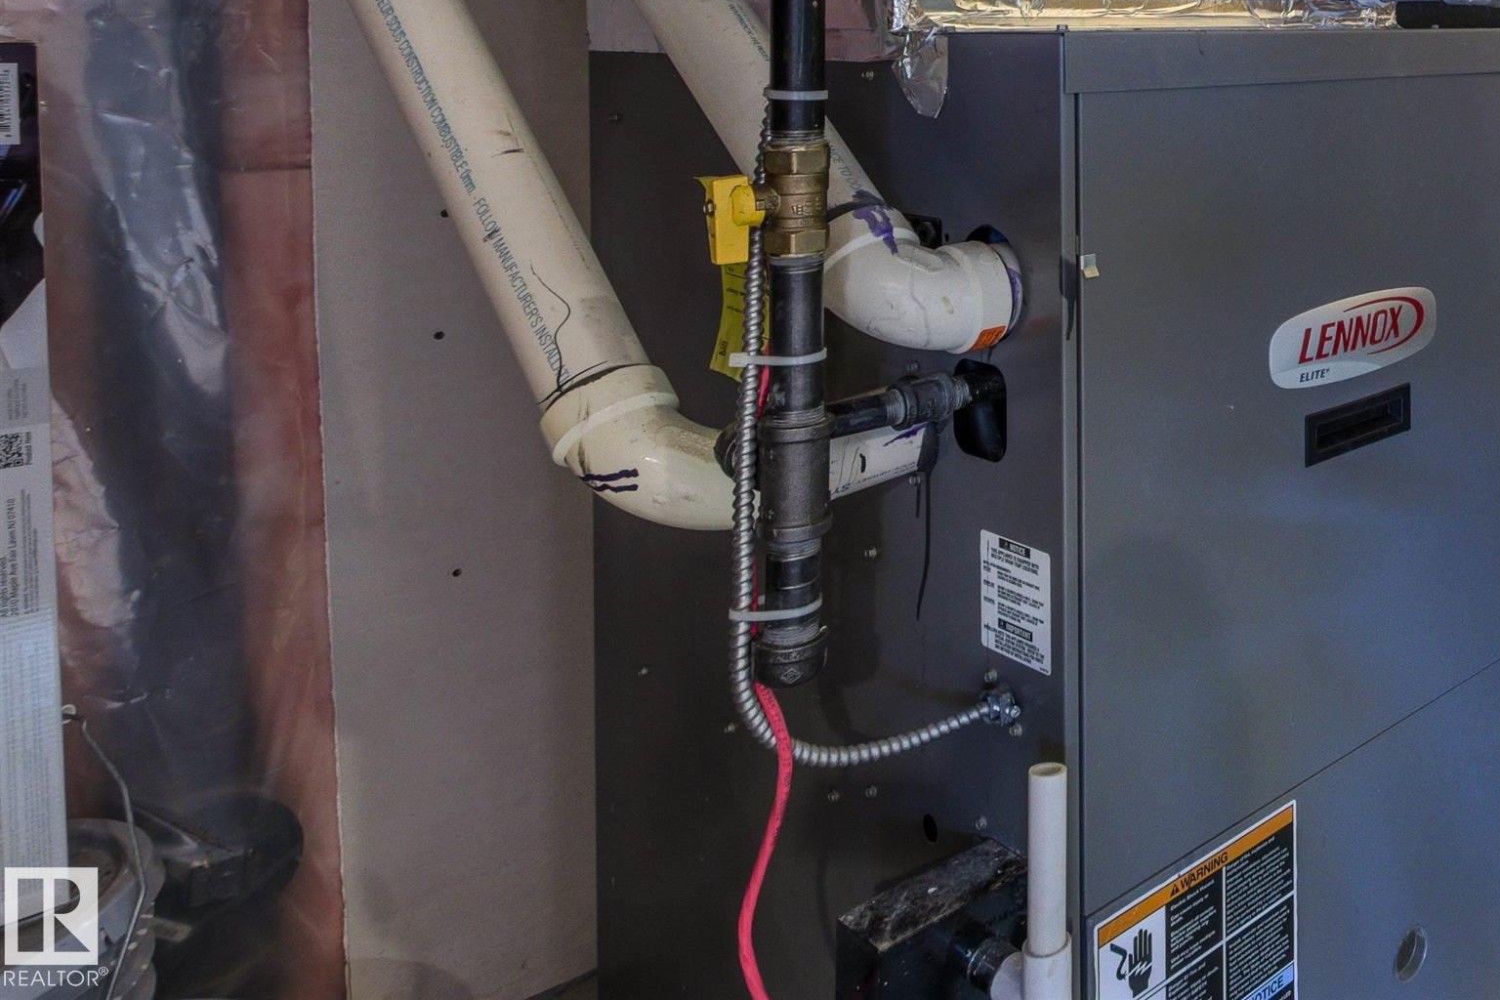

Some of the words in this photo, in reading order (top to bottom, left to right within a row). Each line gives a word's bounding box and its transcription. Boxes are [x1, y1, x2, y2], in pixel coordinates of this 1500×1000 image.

[384, 14, 406, 42] SOUS
[395, 38, 439, 109] CONSTRUCTION
[427, 105, 469, 173] COMBUSTIBLE
[485, 236, 549, 329] MANUFACTURER'S
[1298, 304, 1403, 365] LENNOX
[1179, 851, 1229, 890] WARNING
